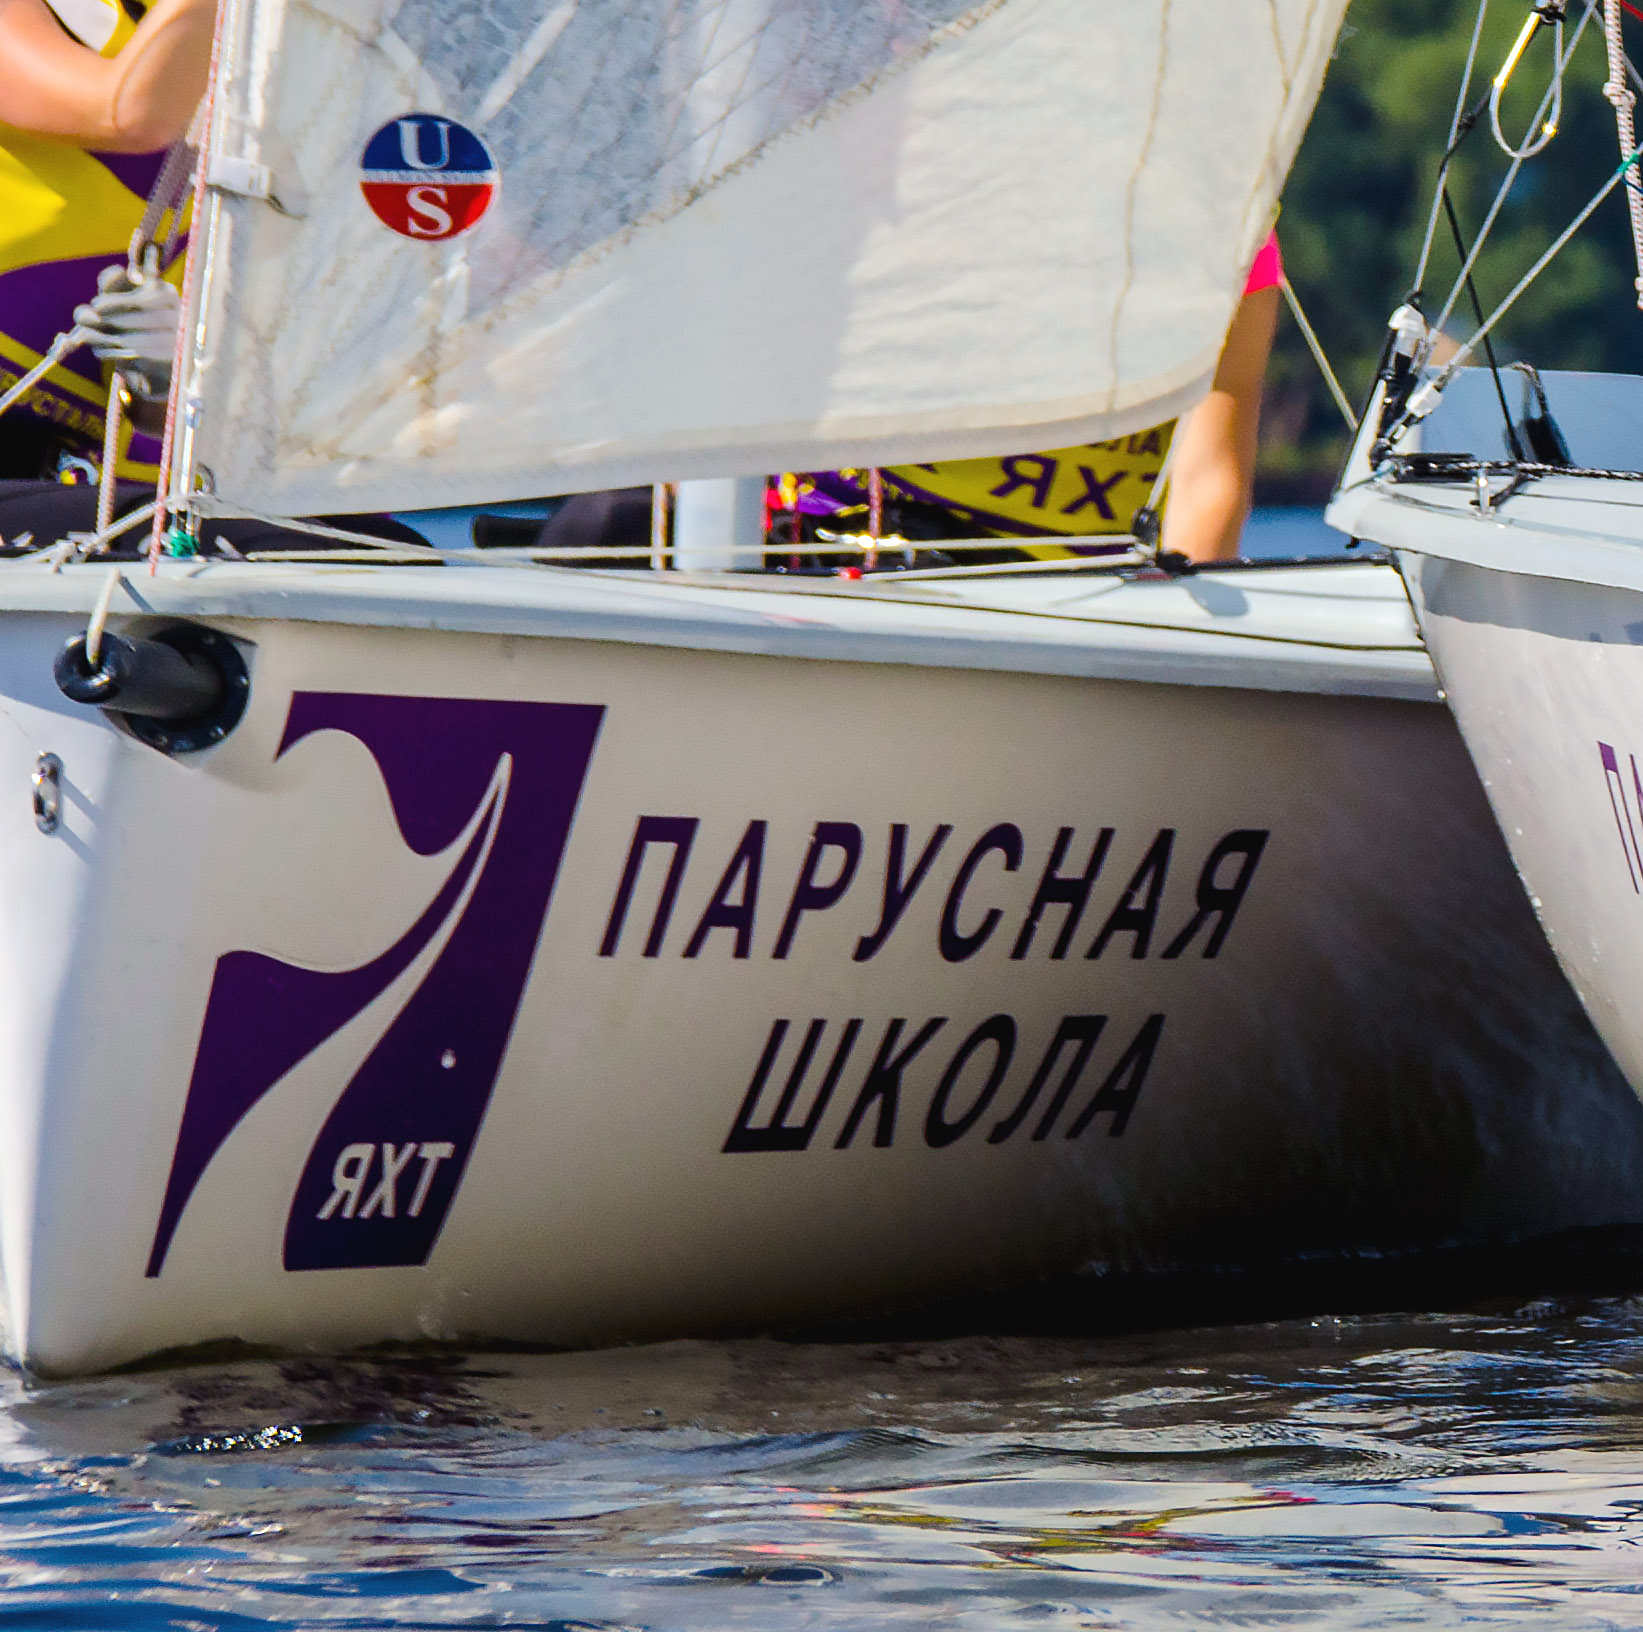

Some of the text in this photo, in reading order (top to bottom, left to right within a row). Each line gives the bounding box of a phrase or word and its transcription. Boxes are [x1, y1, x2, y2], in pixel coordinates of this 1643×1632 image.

[397, 119, 451, 169] U
[406, 186, 454, 236] S
[596, 814, 1272, 963] ПАРУСНАЯ
[720, 1012, 1166, 1154] ШКОЛА
[315, 1141, 456, 1220] ЯХТ
